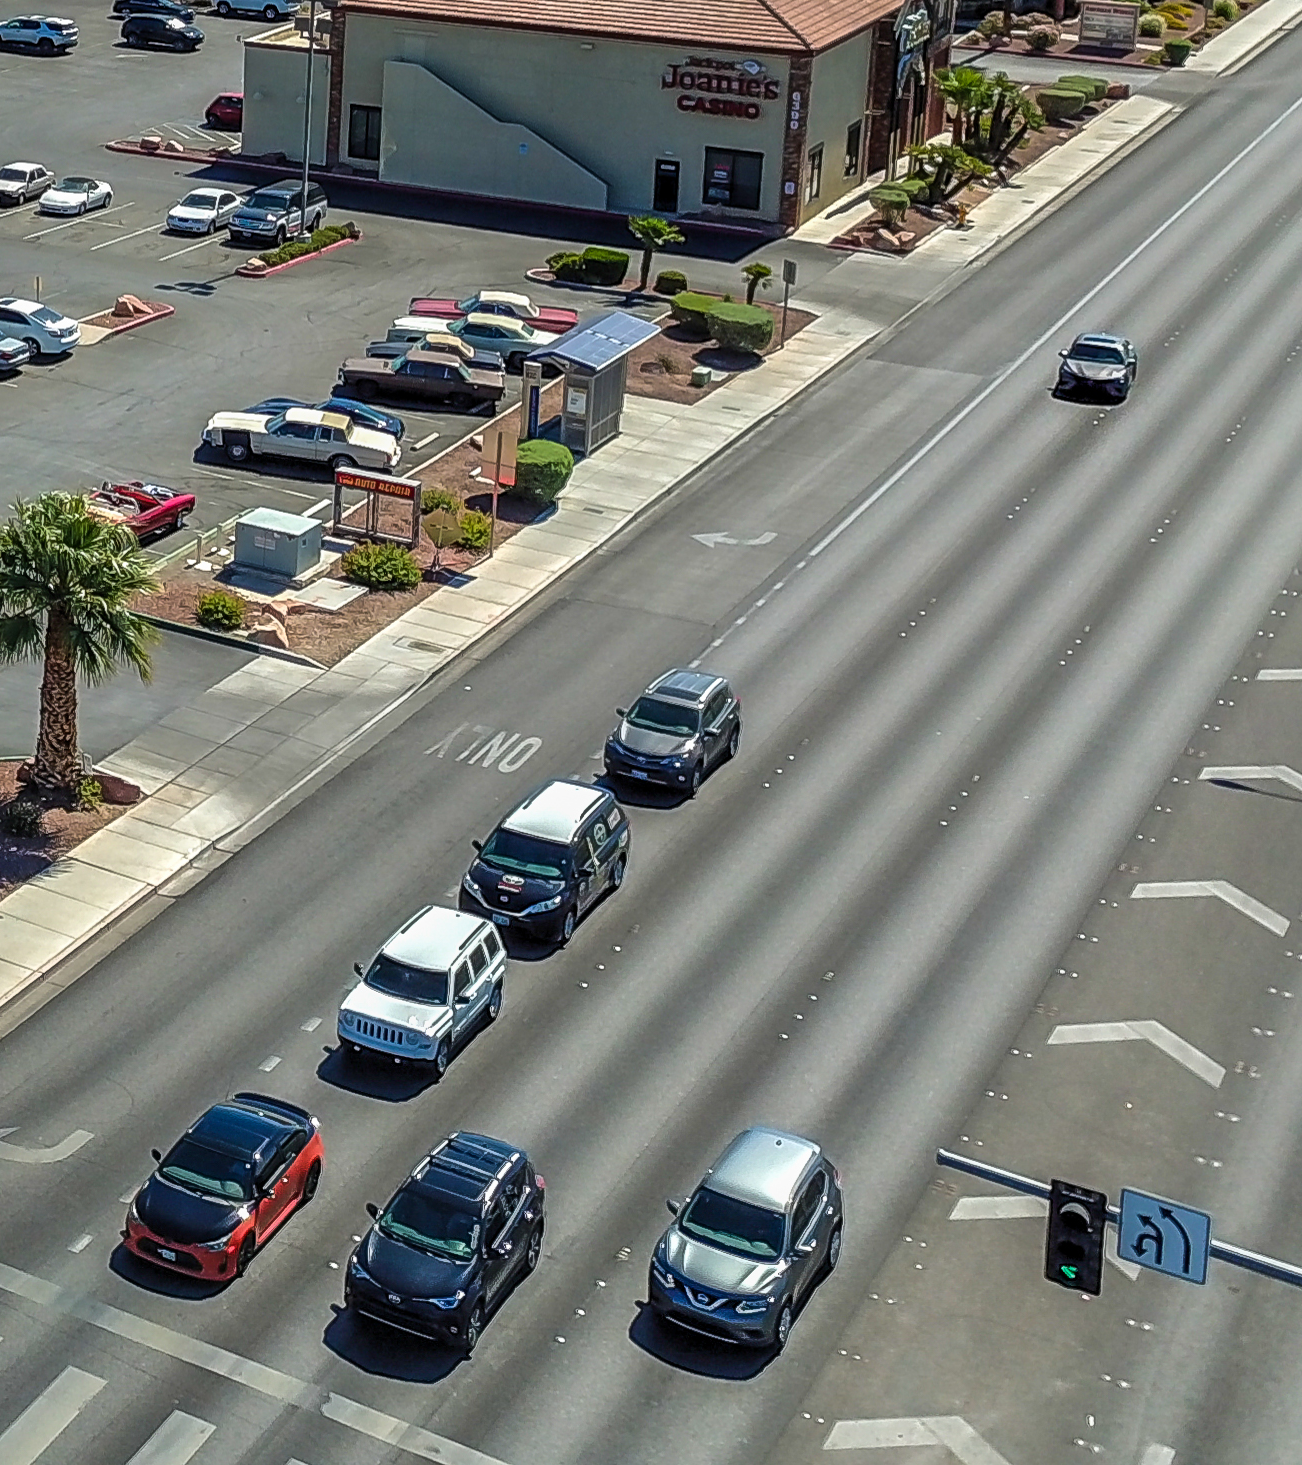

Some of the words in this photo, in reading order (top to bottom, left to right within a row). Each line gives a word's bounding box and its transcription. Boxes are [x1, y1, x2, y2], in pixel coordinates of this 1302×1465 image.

[661, 64, 780, 101] Joanie's
[676, 94, 761, 120] CASINO
[354, 478, 377, 491] AUTO
[378, 481, 411, 497] REPAIR
[423, 721, 543, 774] ONLY
